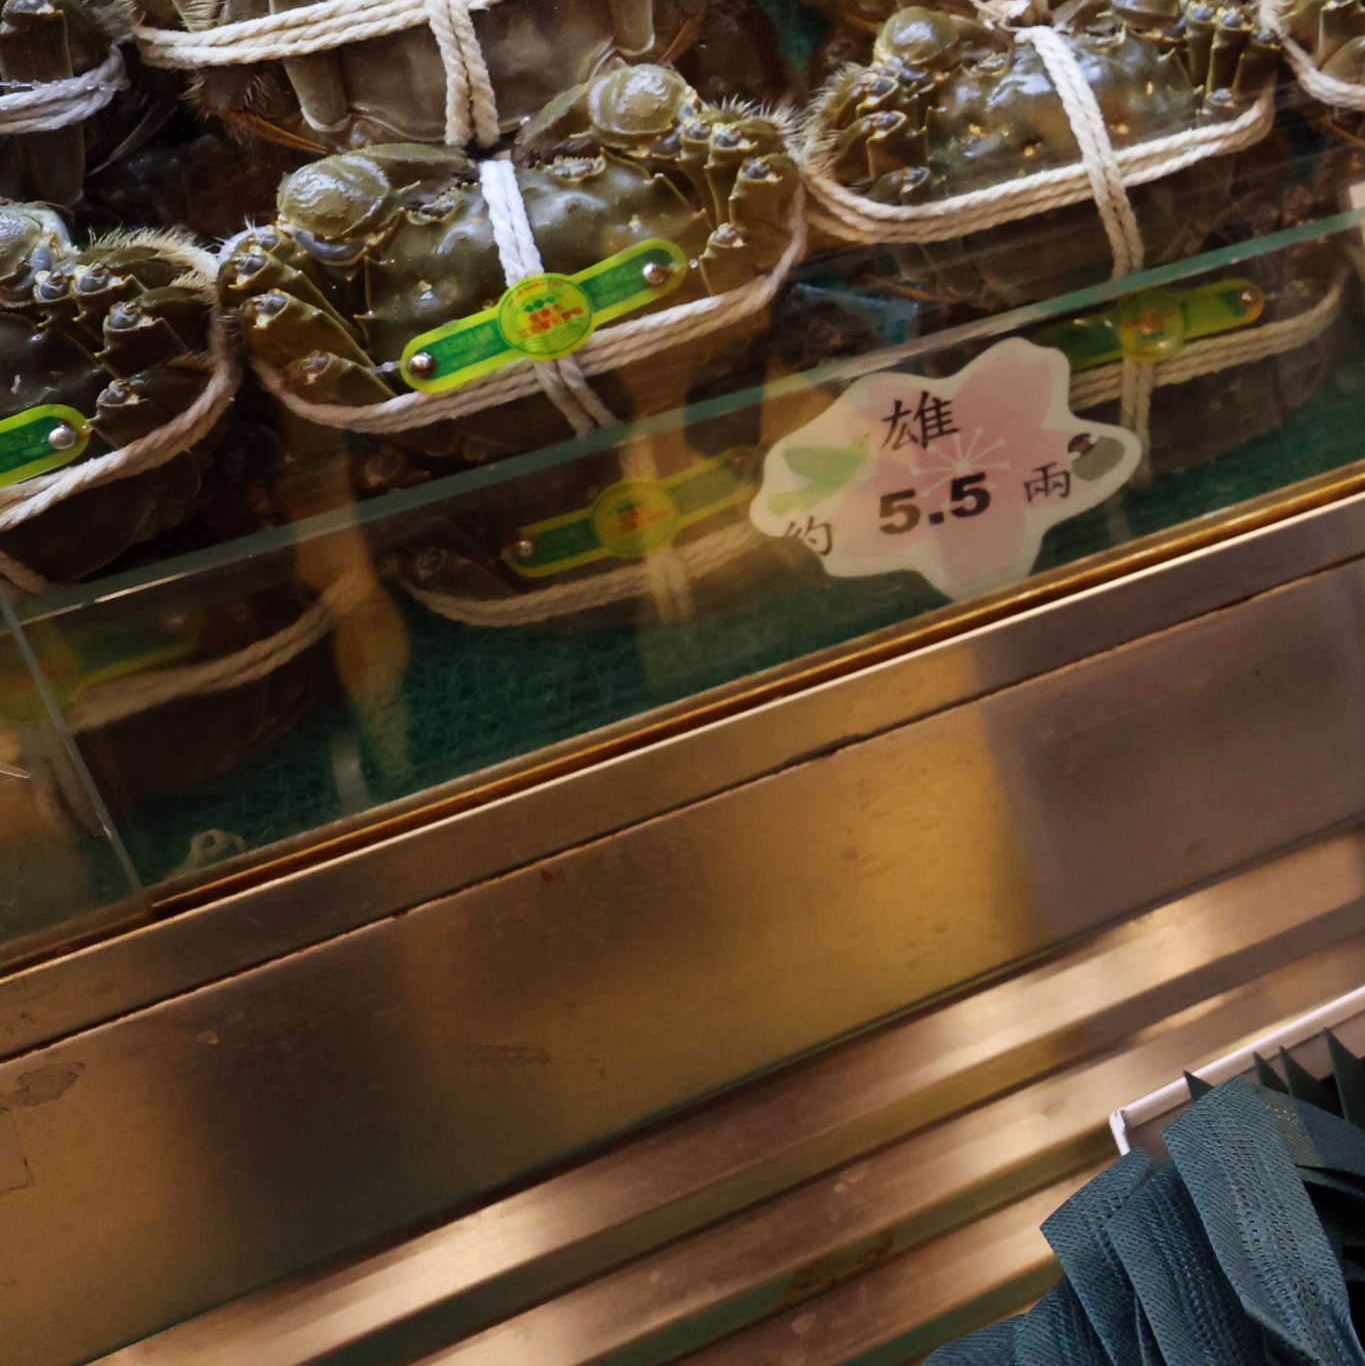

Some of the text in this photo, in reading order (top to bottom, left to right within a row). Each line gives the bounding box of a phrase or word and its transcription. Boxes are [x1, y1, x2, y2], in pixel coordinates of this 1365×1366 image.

[878, 390, 960, 452] 雄
[878, 471, 991, 535] 5.5
[1024, 461, 1071, 503] 兩
